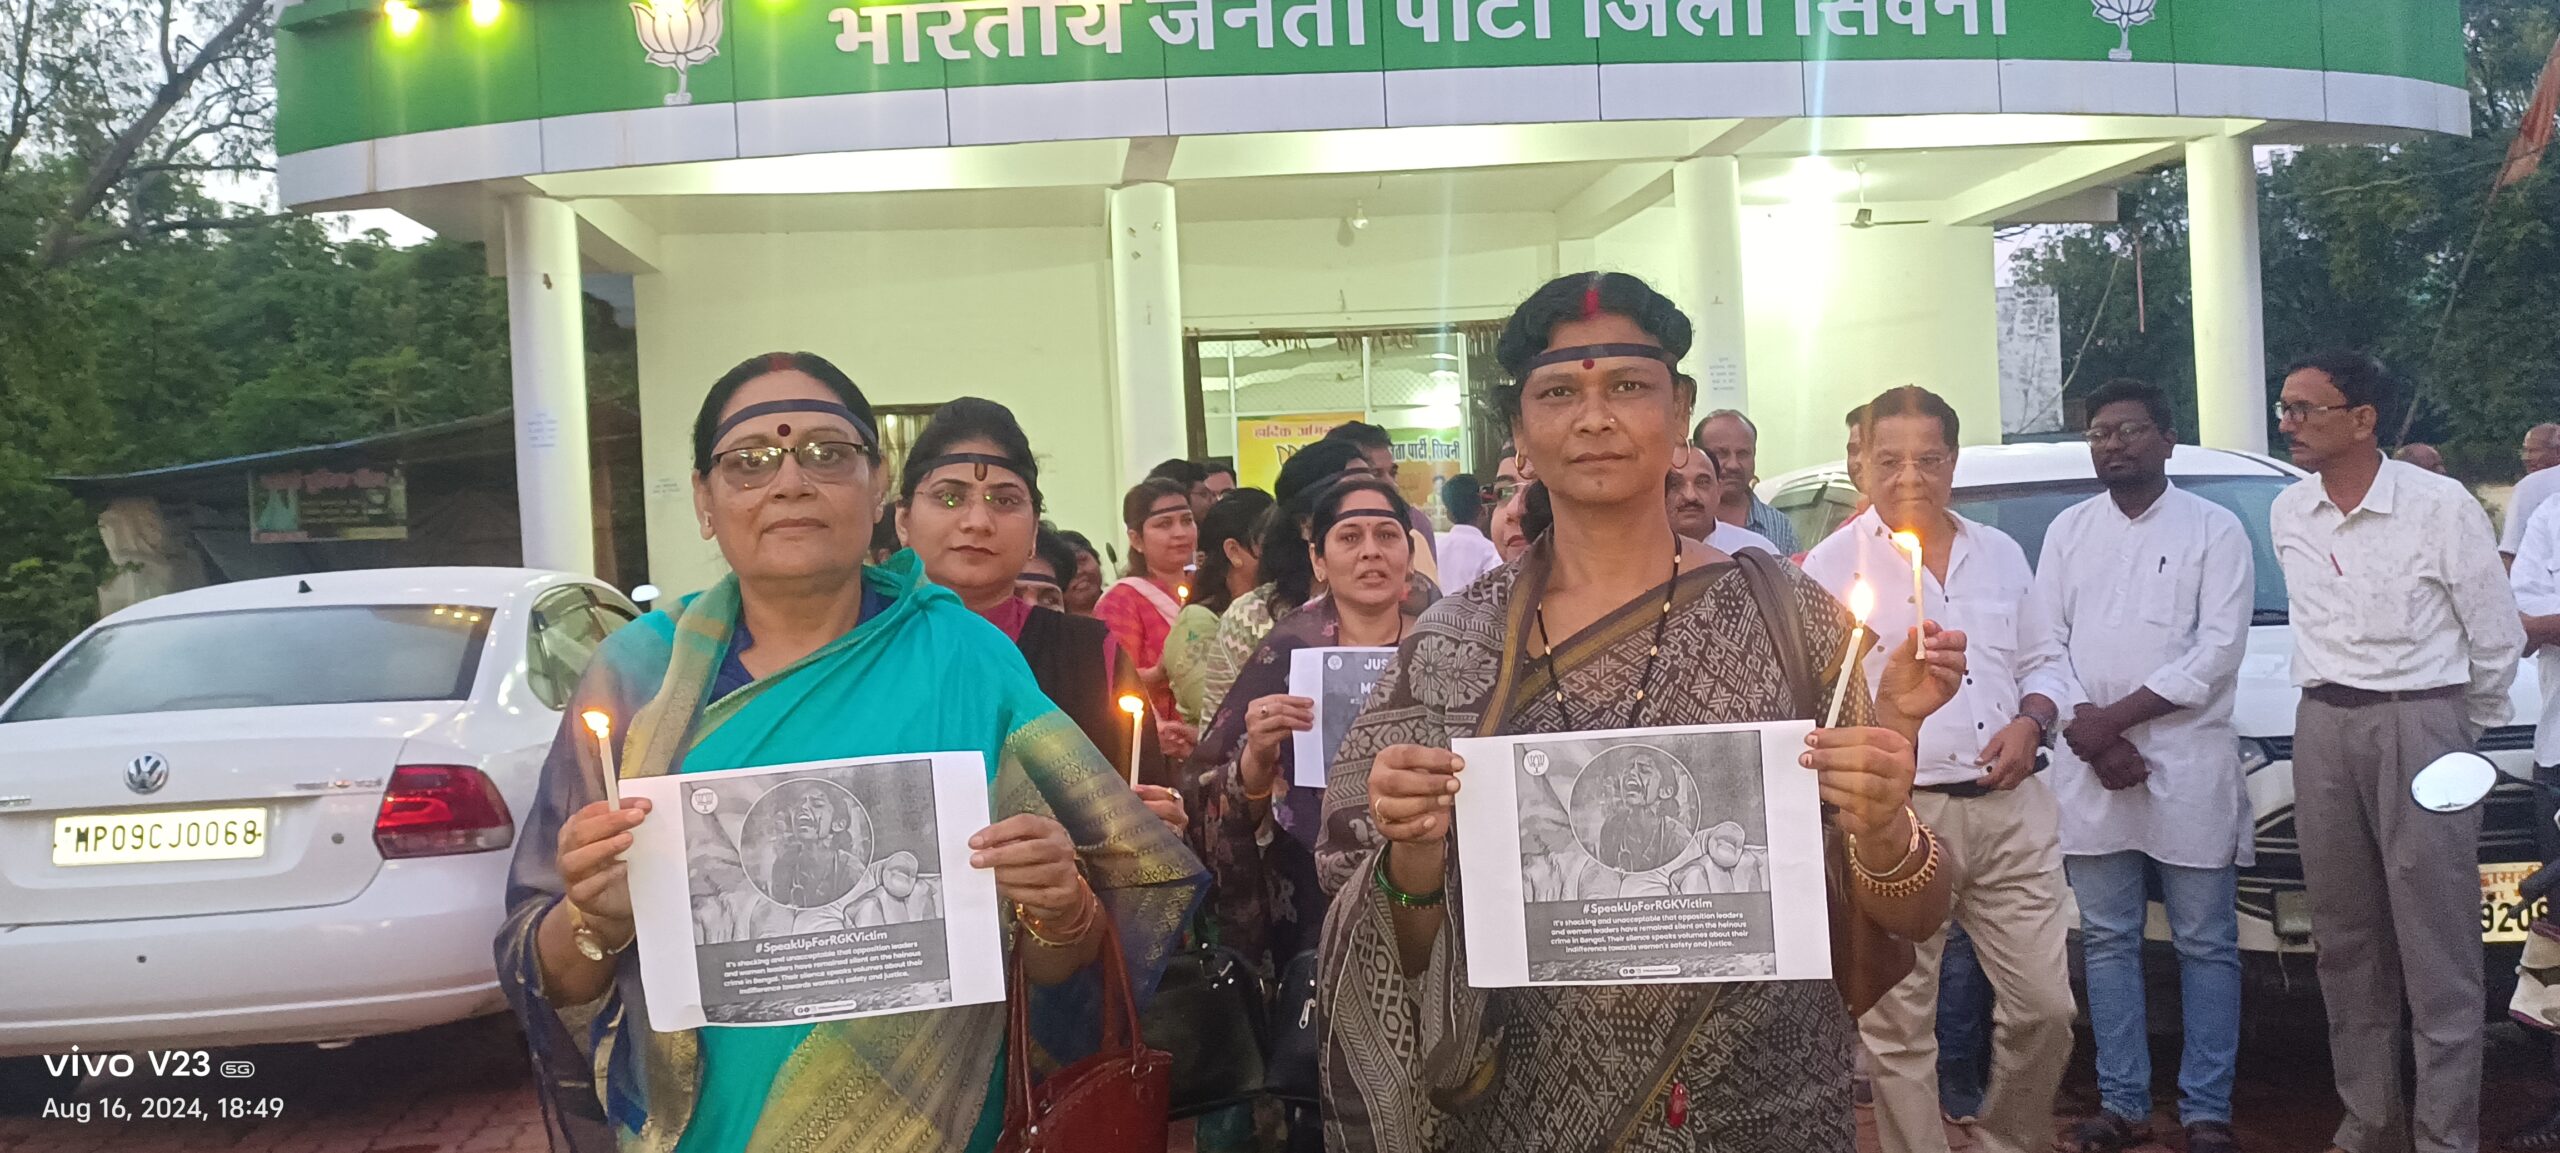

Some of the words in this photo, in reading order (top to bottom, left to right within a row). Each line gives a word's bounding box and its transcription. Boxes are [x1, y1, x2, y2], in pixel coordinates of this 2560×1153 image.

[75, 820, 257, 852] MP09CJ0068
[1582, 898, 1713, 915] #SpeakUpForRGKVictim
[1565, 918, 1597, 926] shocking
[1612, 915, 1661, 925] unacceptable
[1677, 912, 1715, 922] opposition
[1716, 911, 1744, 919] leaders
[1550, 928, 1566, 936] and
[1593, 926, 1619, 934] leaders
[1620, 925, 1638, 933] have
[1639, 923, 1673, 932] remained
[1674, 922, 1694, 930] silent
[1717, 920, 1747, 928] heinous
[1625, 934, 1650, 942] silence
[1651, 933, 1677, 941] speaks
[1708, 930, 1730, 938] about
[1731, 929, 1749, 937] their
[755, 930, 888, 954] #SpeakUpForRGKVictim
[1608, 944, 1637, 952] towards
[1637, 942, 1669, 950] women's
[1670, 941, 1692, 950] safety
[1693, 940, 1708, 948] and
